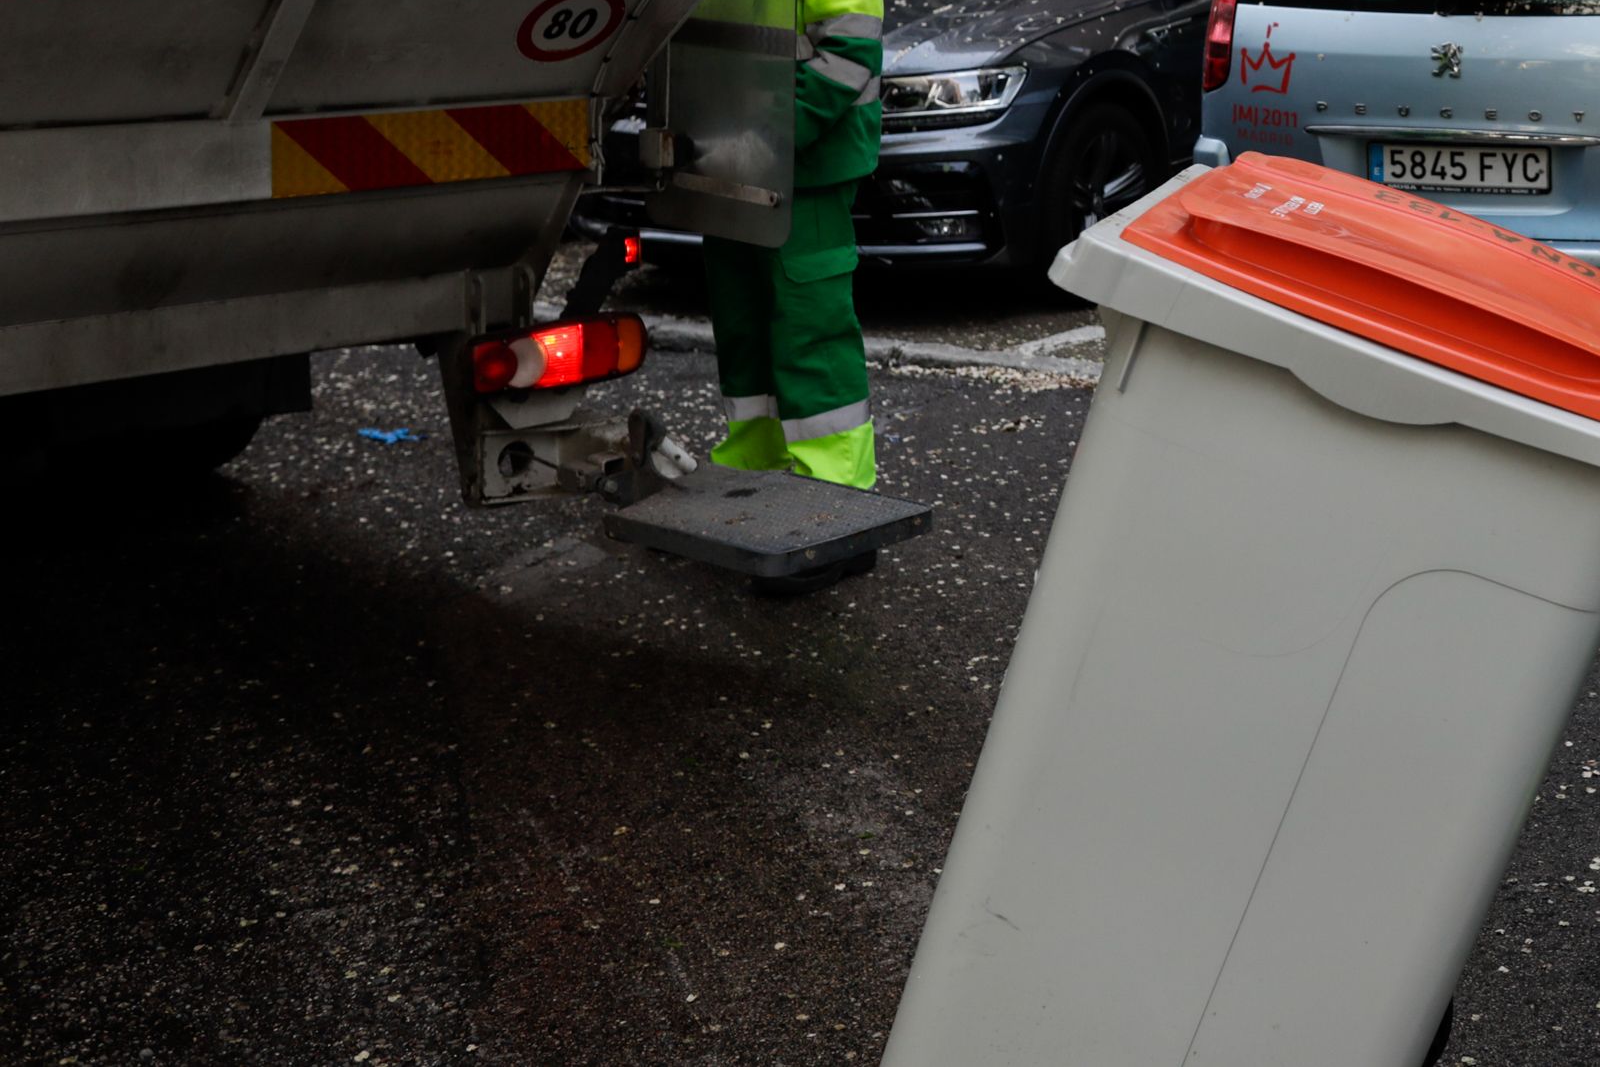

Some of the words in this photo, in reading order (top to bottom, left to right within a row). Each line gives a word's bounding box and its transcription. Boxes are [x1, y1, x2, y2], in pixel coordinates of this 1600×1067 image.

[543, 7, 599, 40] 80
[1231, 102, 1259, 128] JMJ
[1261, 107, 1298, 128] 2011
[1315, 100, 1585, 124] PEUGEOT
[1389, 149, 1468, 181] 5845
[1479, 151, 1541, 183] FYC
